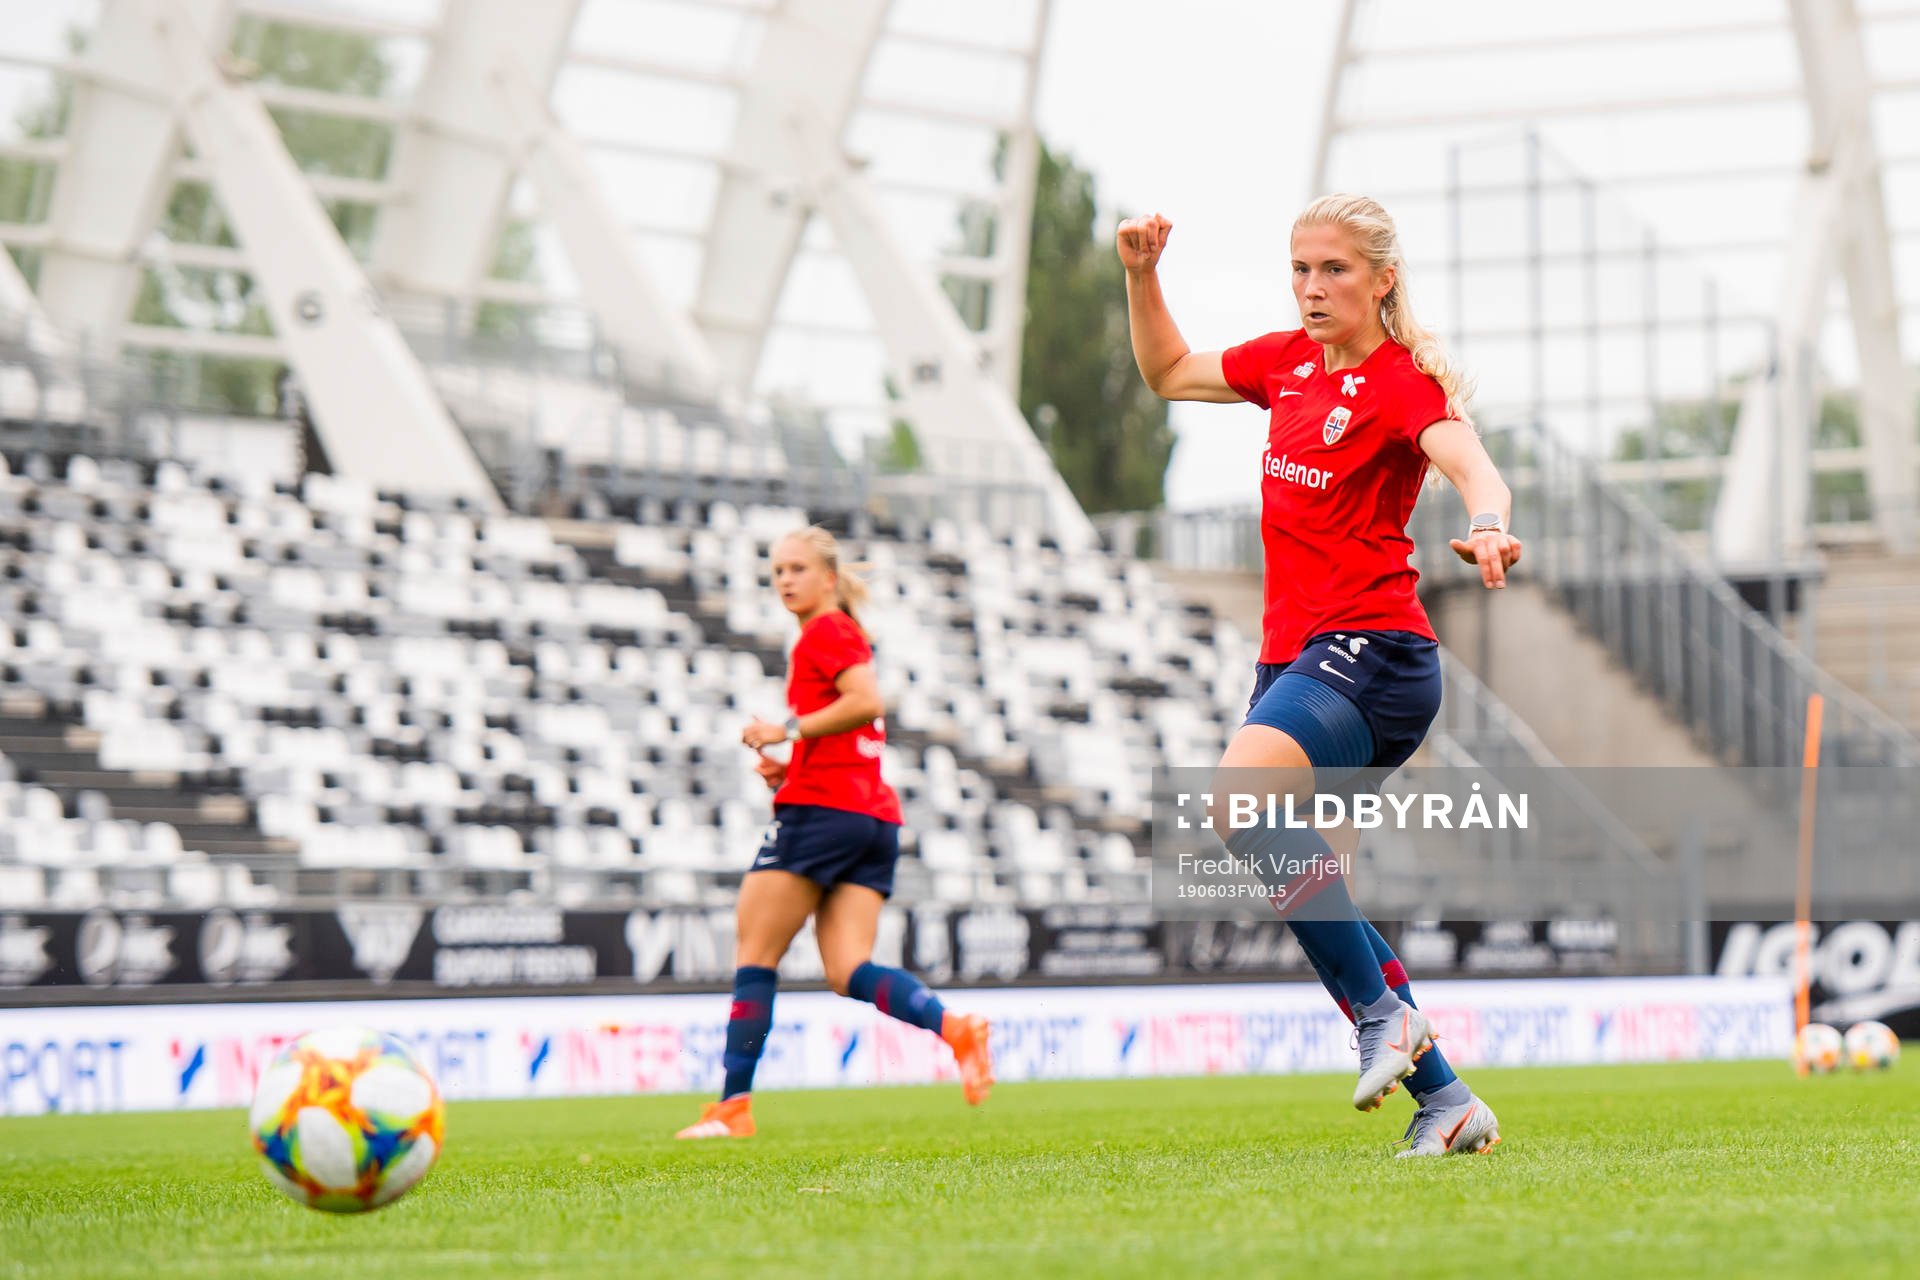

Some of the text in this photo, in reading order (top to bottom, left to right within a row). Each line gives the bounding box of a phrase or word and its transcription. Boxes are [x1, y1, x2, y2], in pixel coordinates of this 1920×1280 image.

[1264, 451, 1334, 490] telenor
[1327, 644, 1357, 664] telenor
[1149, 1011, 1341, 1074] INTERSPORT
